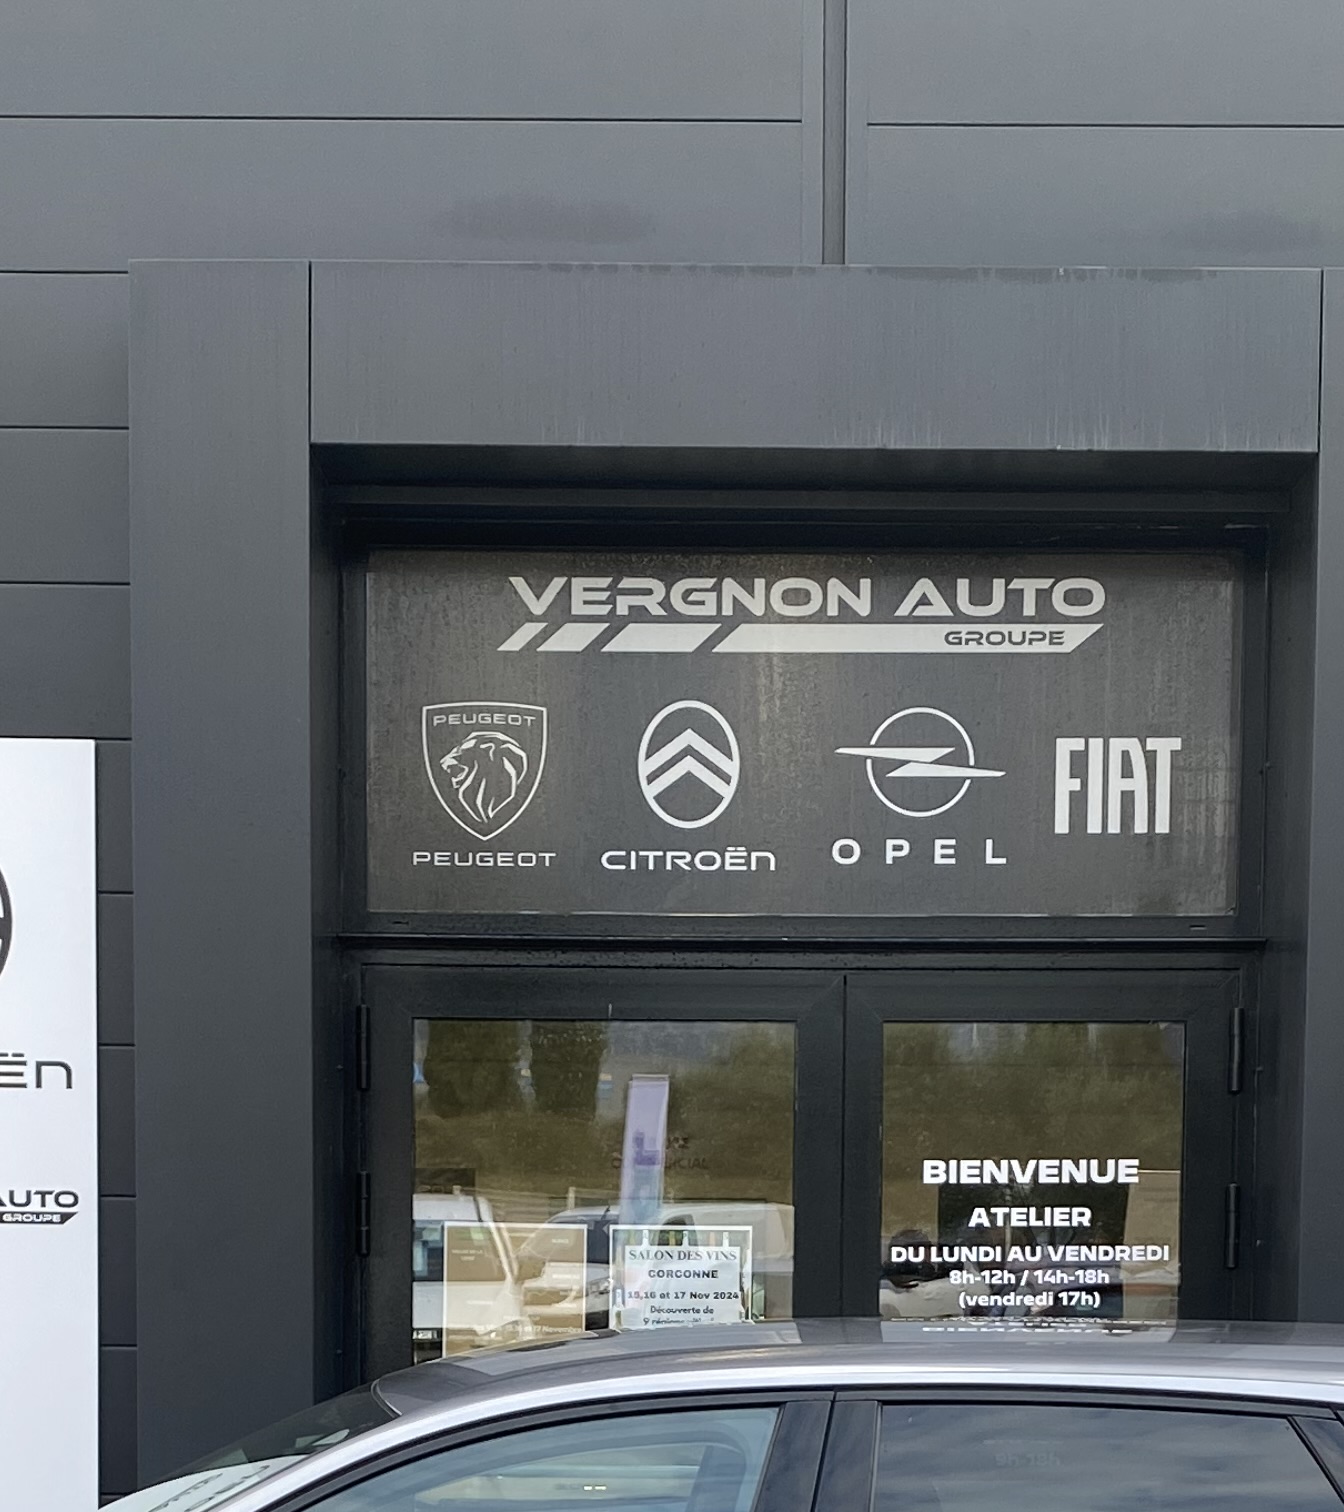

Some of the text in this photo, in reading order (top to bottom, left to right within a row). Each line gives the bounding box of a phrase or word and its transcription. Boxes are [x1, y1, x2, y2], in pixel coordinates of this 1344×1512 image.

[508, 576, 1106, 619] VERGNON AUTO
[944, 629, 1066, 646] GROUPE
[433, 712, 536, 729] PEUGEOT
[1055, 737, 1181, 834] FIAT
[412, 850, 556, 868] PEUGEOT
[831, 838, 1006, 865] OPEL
[922, 1159, 1140, 1184] BIENVENUE
[2, 1213, 61, 1222] GROUPE
[967, 1207, 1092, 1228] ATELIER
[628, 1250, 737, 1260] SALON DES VINS
[891, 1245, 1169, 1262] DU LUNDI AU VENDREDI
[648, 1270, 718, 1279] CORCONNE
[949, 1269, 1016, 1285] 8h-12h
[1034, 1269, 1110, 1285] 14h-18h
[674, 1291, 686, 1300] 17
[690, 1291, 710, 1300] Nov
[713, 1291, 739, 1300] 2024
[958, 1290, 1101, 1309] (vendredi 17h)
